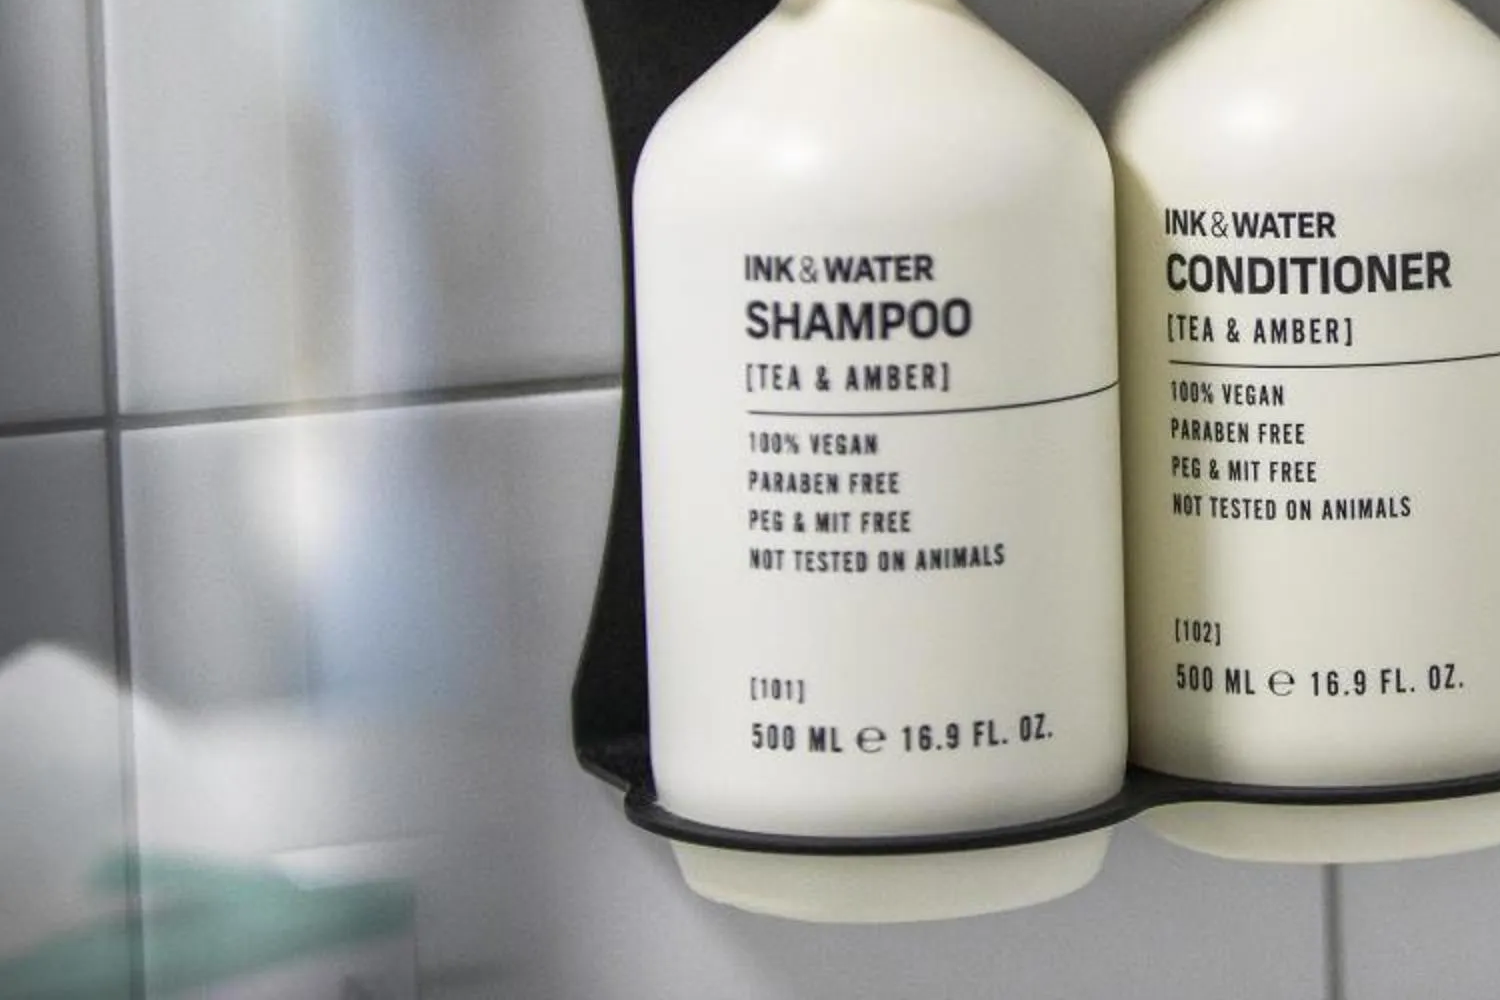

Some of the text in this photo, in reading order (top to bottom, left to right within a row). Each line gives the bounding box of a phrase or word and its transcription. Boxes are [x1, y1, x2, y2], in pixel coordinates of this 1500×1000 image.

[1164, 207, 1337, 240] INK&WATER
[744, 253, 935, 284] INK&WATER
[1166, 250, 1453, 295] CONDITIONER
[745, 297, 973, 342] SHAMPOO
[1167, 313, 1353, 347] [TEA & AMBER]
[745, 361, 950, 393] [TEA & AMBER]
[1170, 379, 1285, 407] 100% VEGAN
[748, 431, 879, 456] 100% VEGAN
[1170, 416, 1305, 446] PARABEN FREE
[748, 469, 901, 496] PARABEN FREE
[1171, 455, 1318, 484] PEG & MIT FREE
[748, 508, 911, 534] PEG & MIT FREE
[1172, 492, 1411, 521] NOT TESTED ON ANIMALS
[749, 542, 1005, 574] NOT TESTED ON ANIMALS
[1174, 617, 1222, 647] [102]
[749, 676, 806, 705] [101]
[1176, 662, 1214, 693] 500
[1224, 667, 1256, 696] ML
[1310, 668, 1367, 697] 16.9
[1379, 667, 1416, 695] FL.
[1427, 662, 1464, 692] OZ.
[751, 722, 796, 752] 500
[807, 725, 844, 754] ML
[901, 723, 961, 753] 16.9
[972, 719, 1009, 748] FL.
[1019, 712, 1054, 743] OZ.
